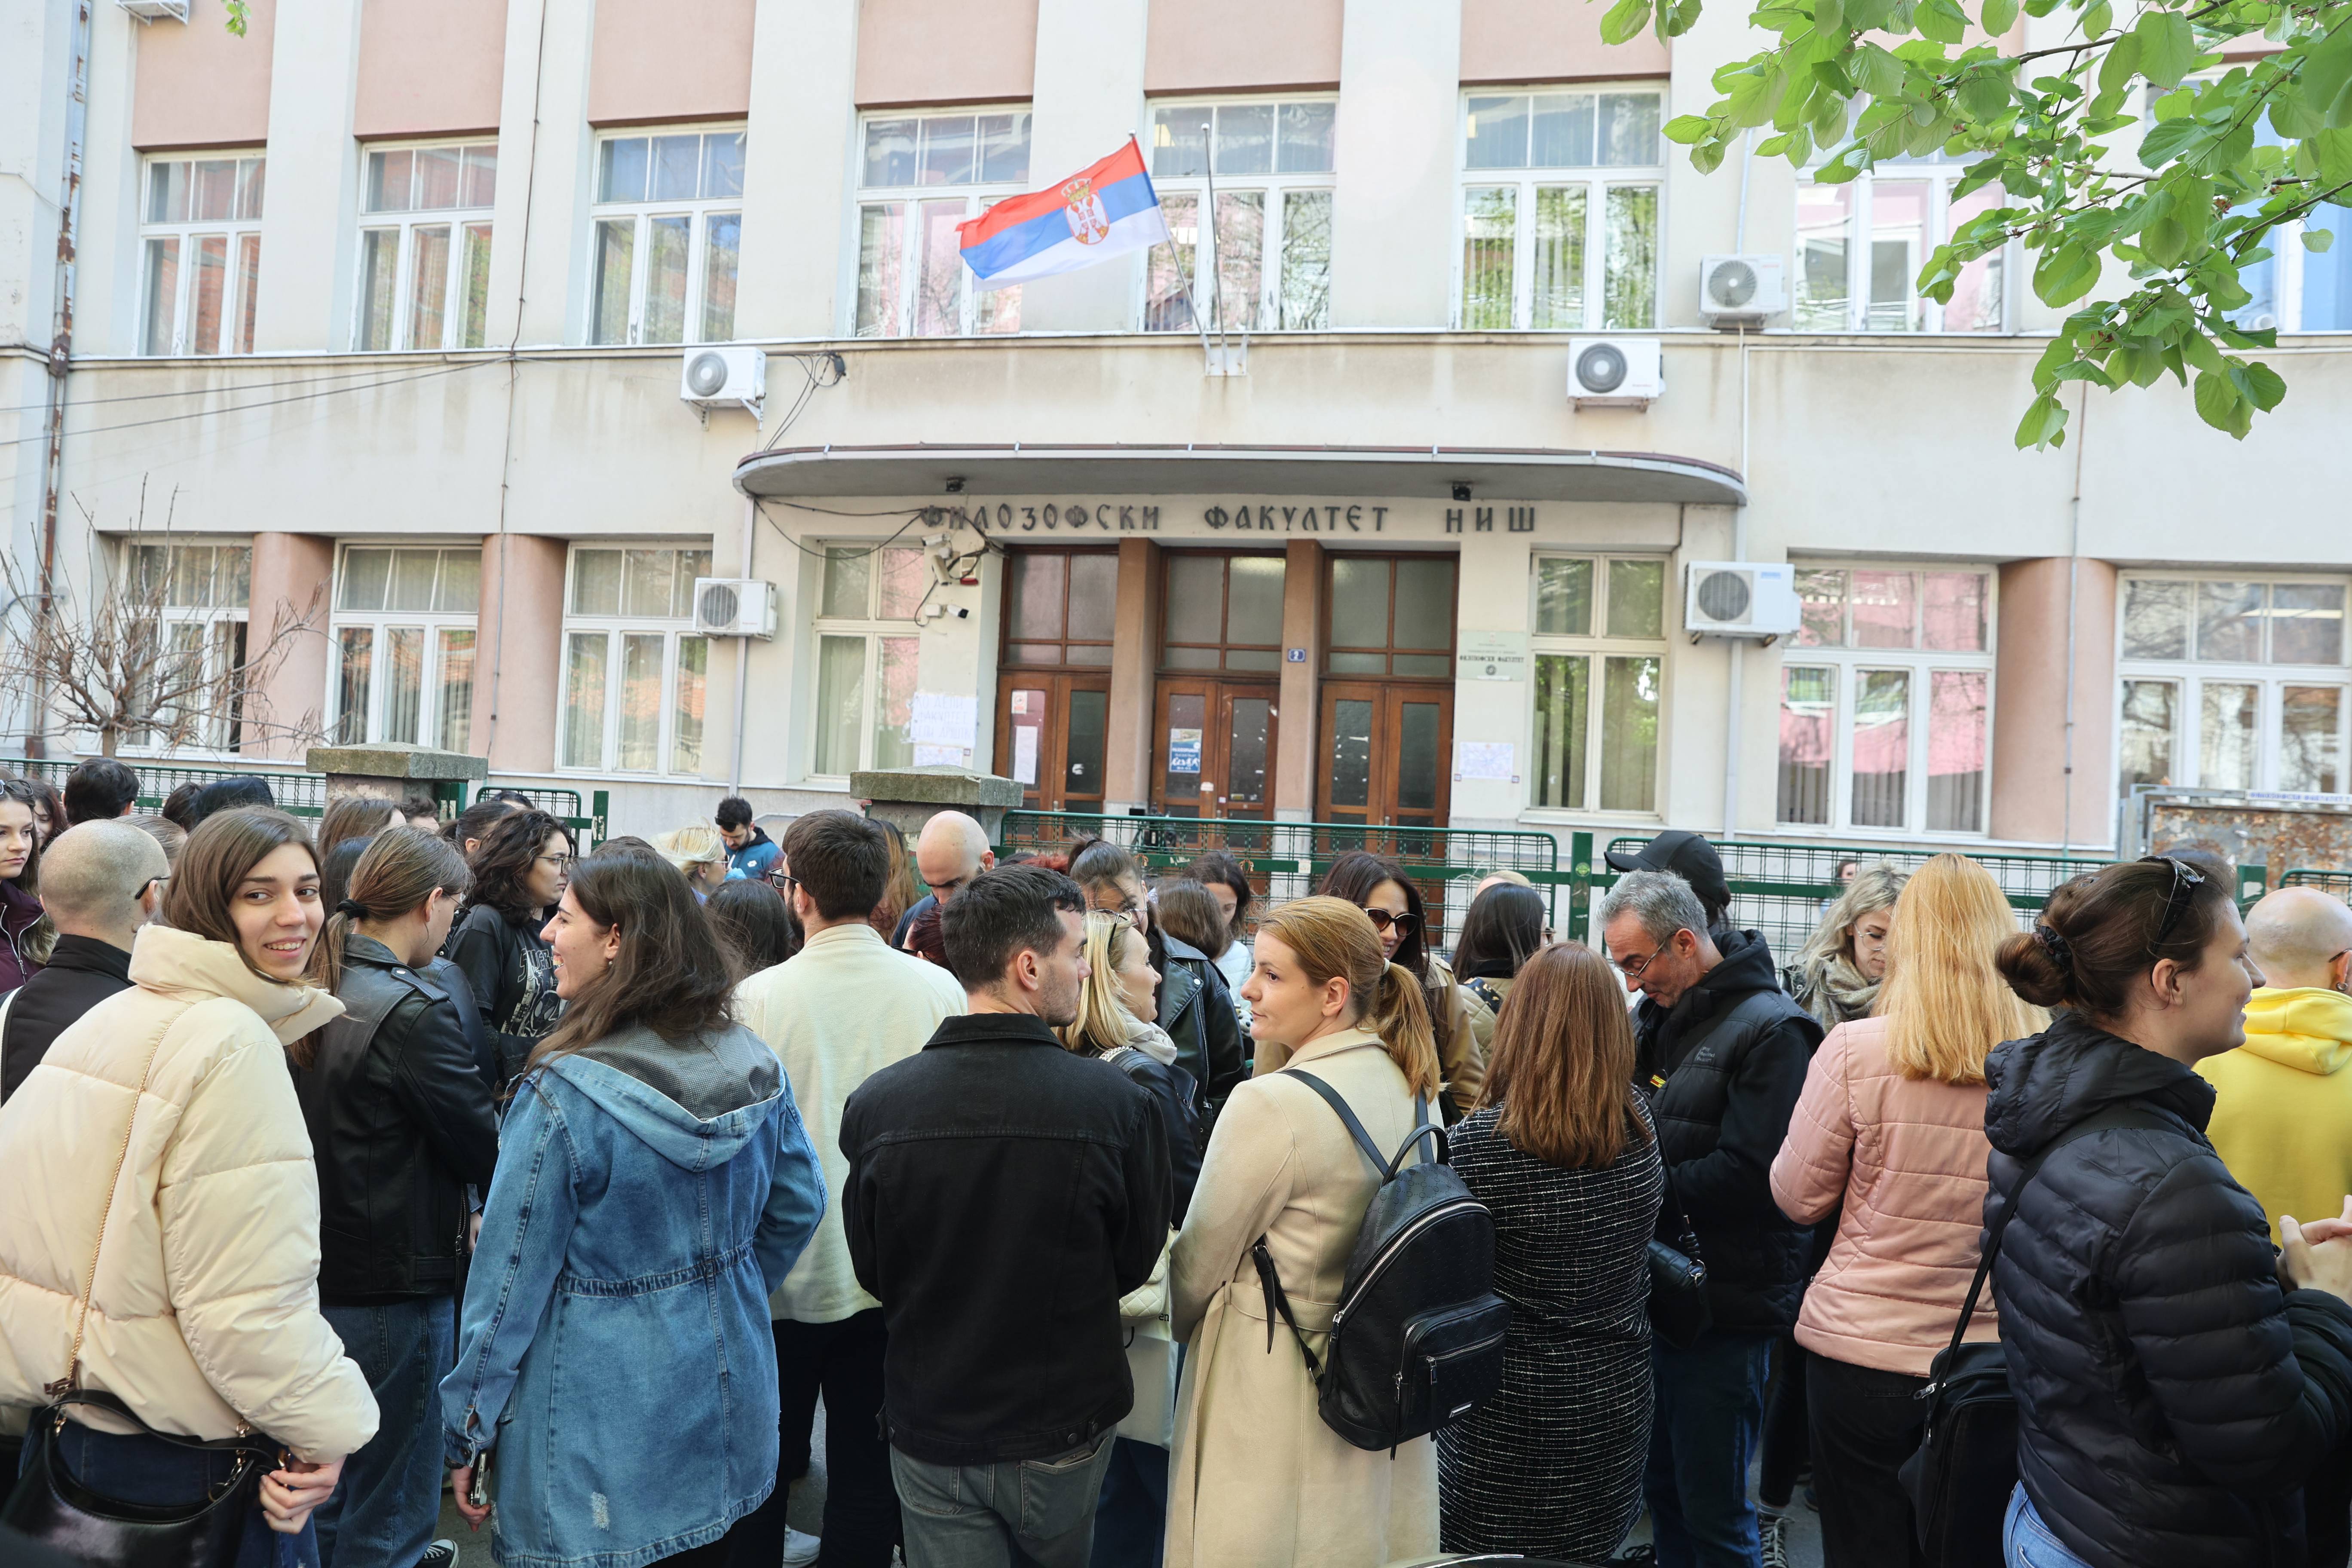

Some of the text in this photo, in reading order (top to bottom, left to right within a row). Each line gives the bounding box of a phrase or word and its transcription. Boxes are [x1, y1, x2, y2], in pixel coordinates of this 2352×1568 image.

[920, 503, 1535, 533] ФИЛОЗОФСКИ ФАКУЛТЕТ НИШ
[1294, 650, 1299, 660] 2
